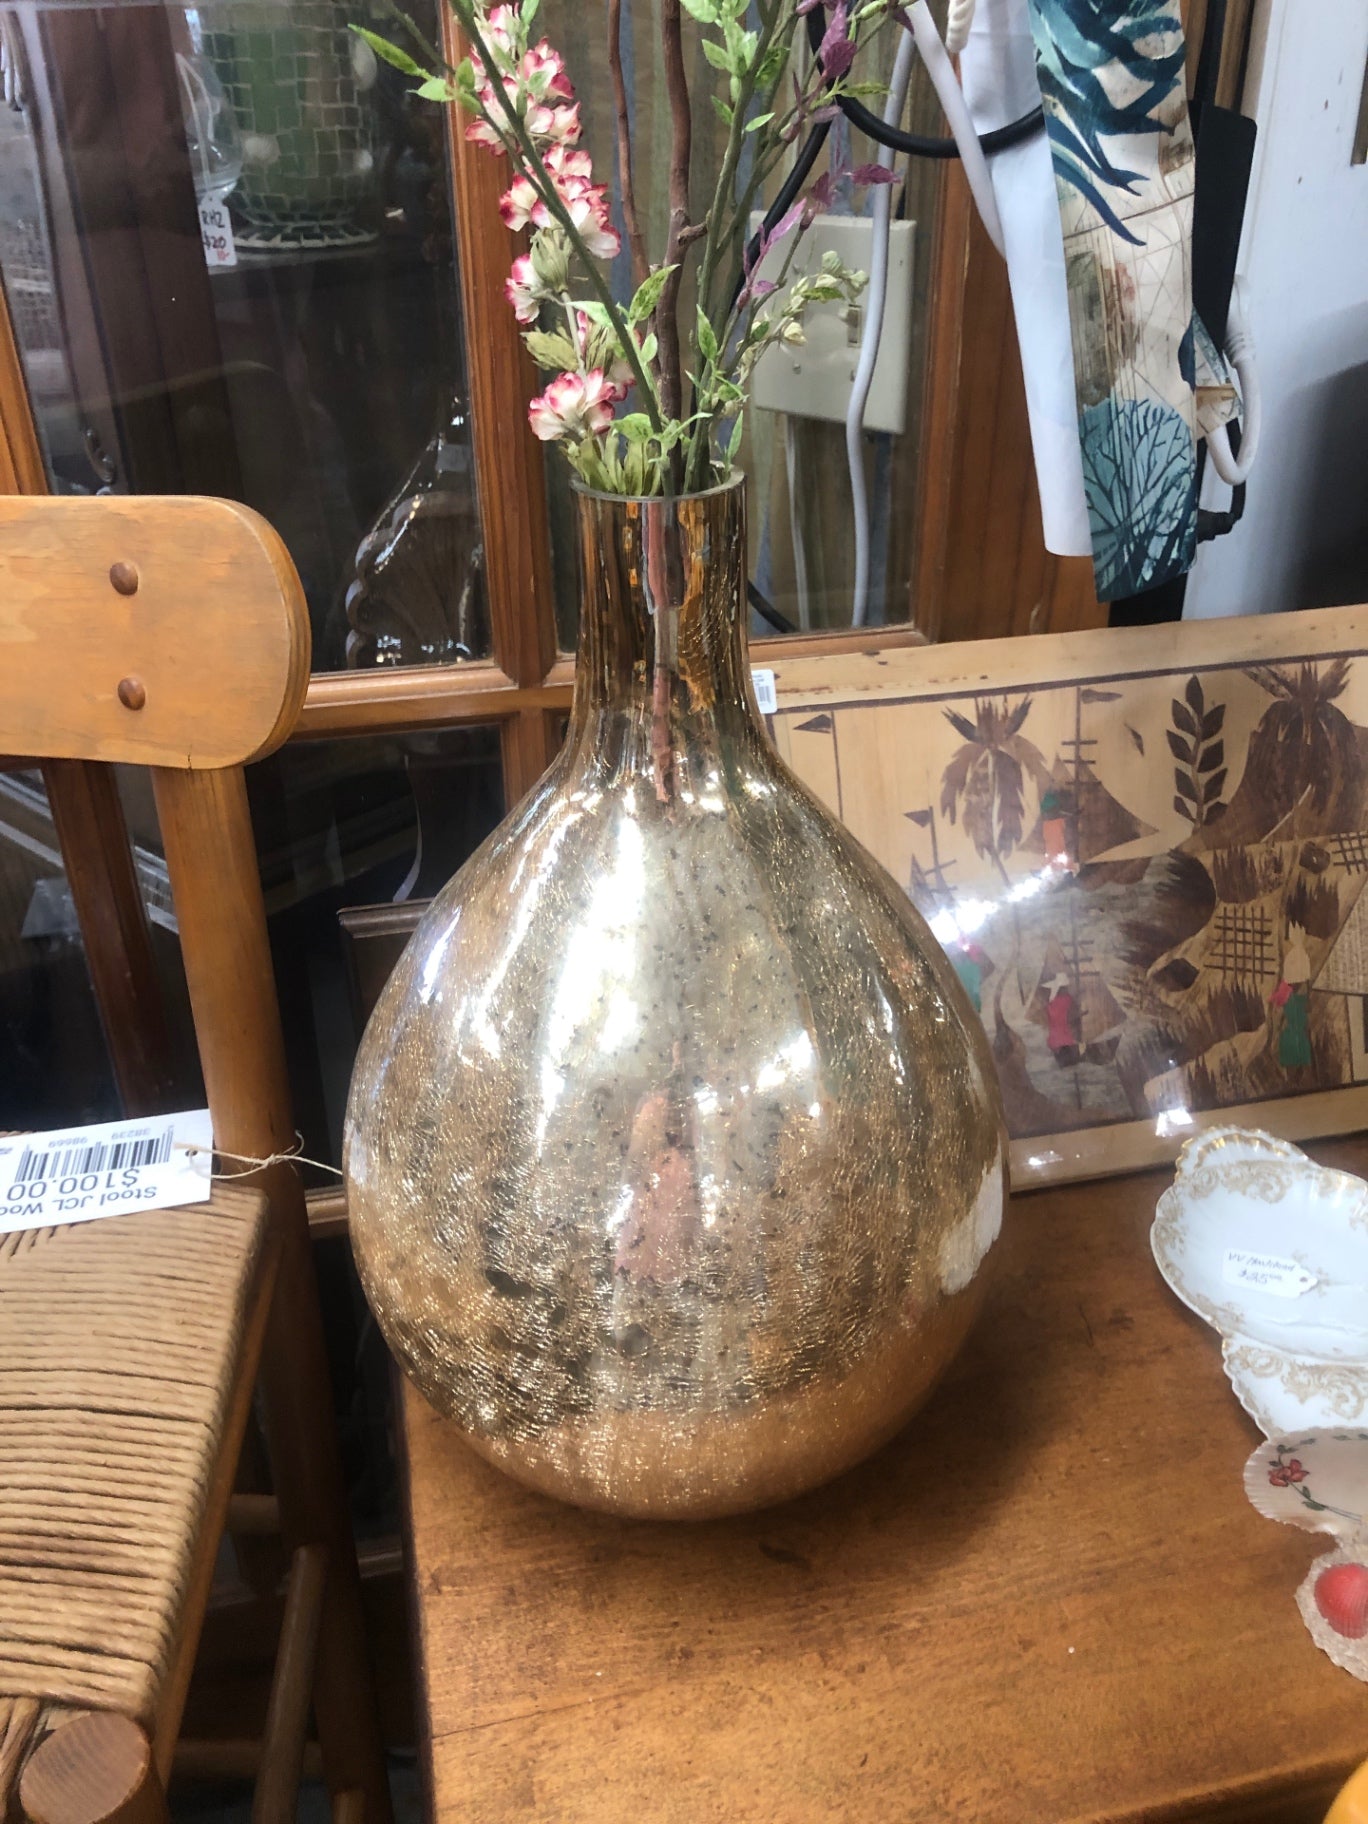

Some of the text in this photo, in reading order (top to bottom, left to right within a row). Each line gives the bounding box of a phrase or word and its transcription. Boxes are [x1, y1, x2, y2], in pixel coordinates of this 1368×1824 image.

[7, 1169, 140, 1202] $100.00
[52, 1195, 94, 1211] JCL
[100, 1187, 157, 1206] Stool
